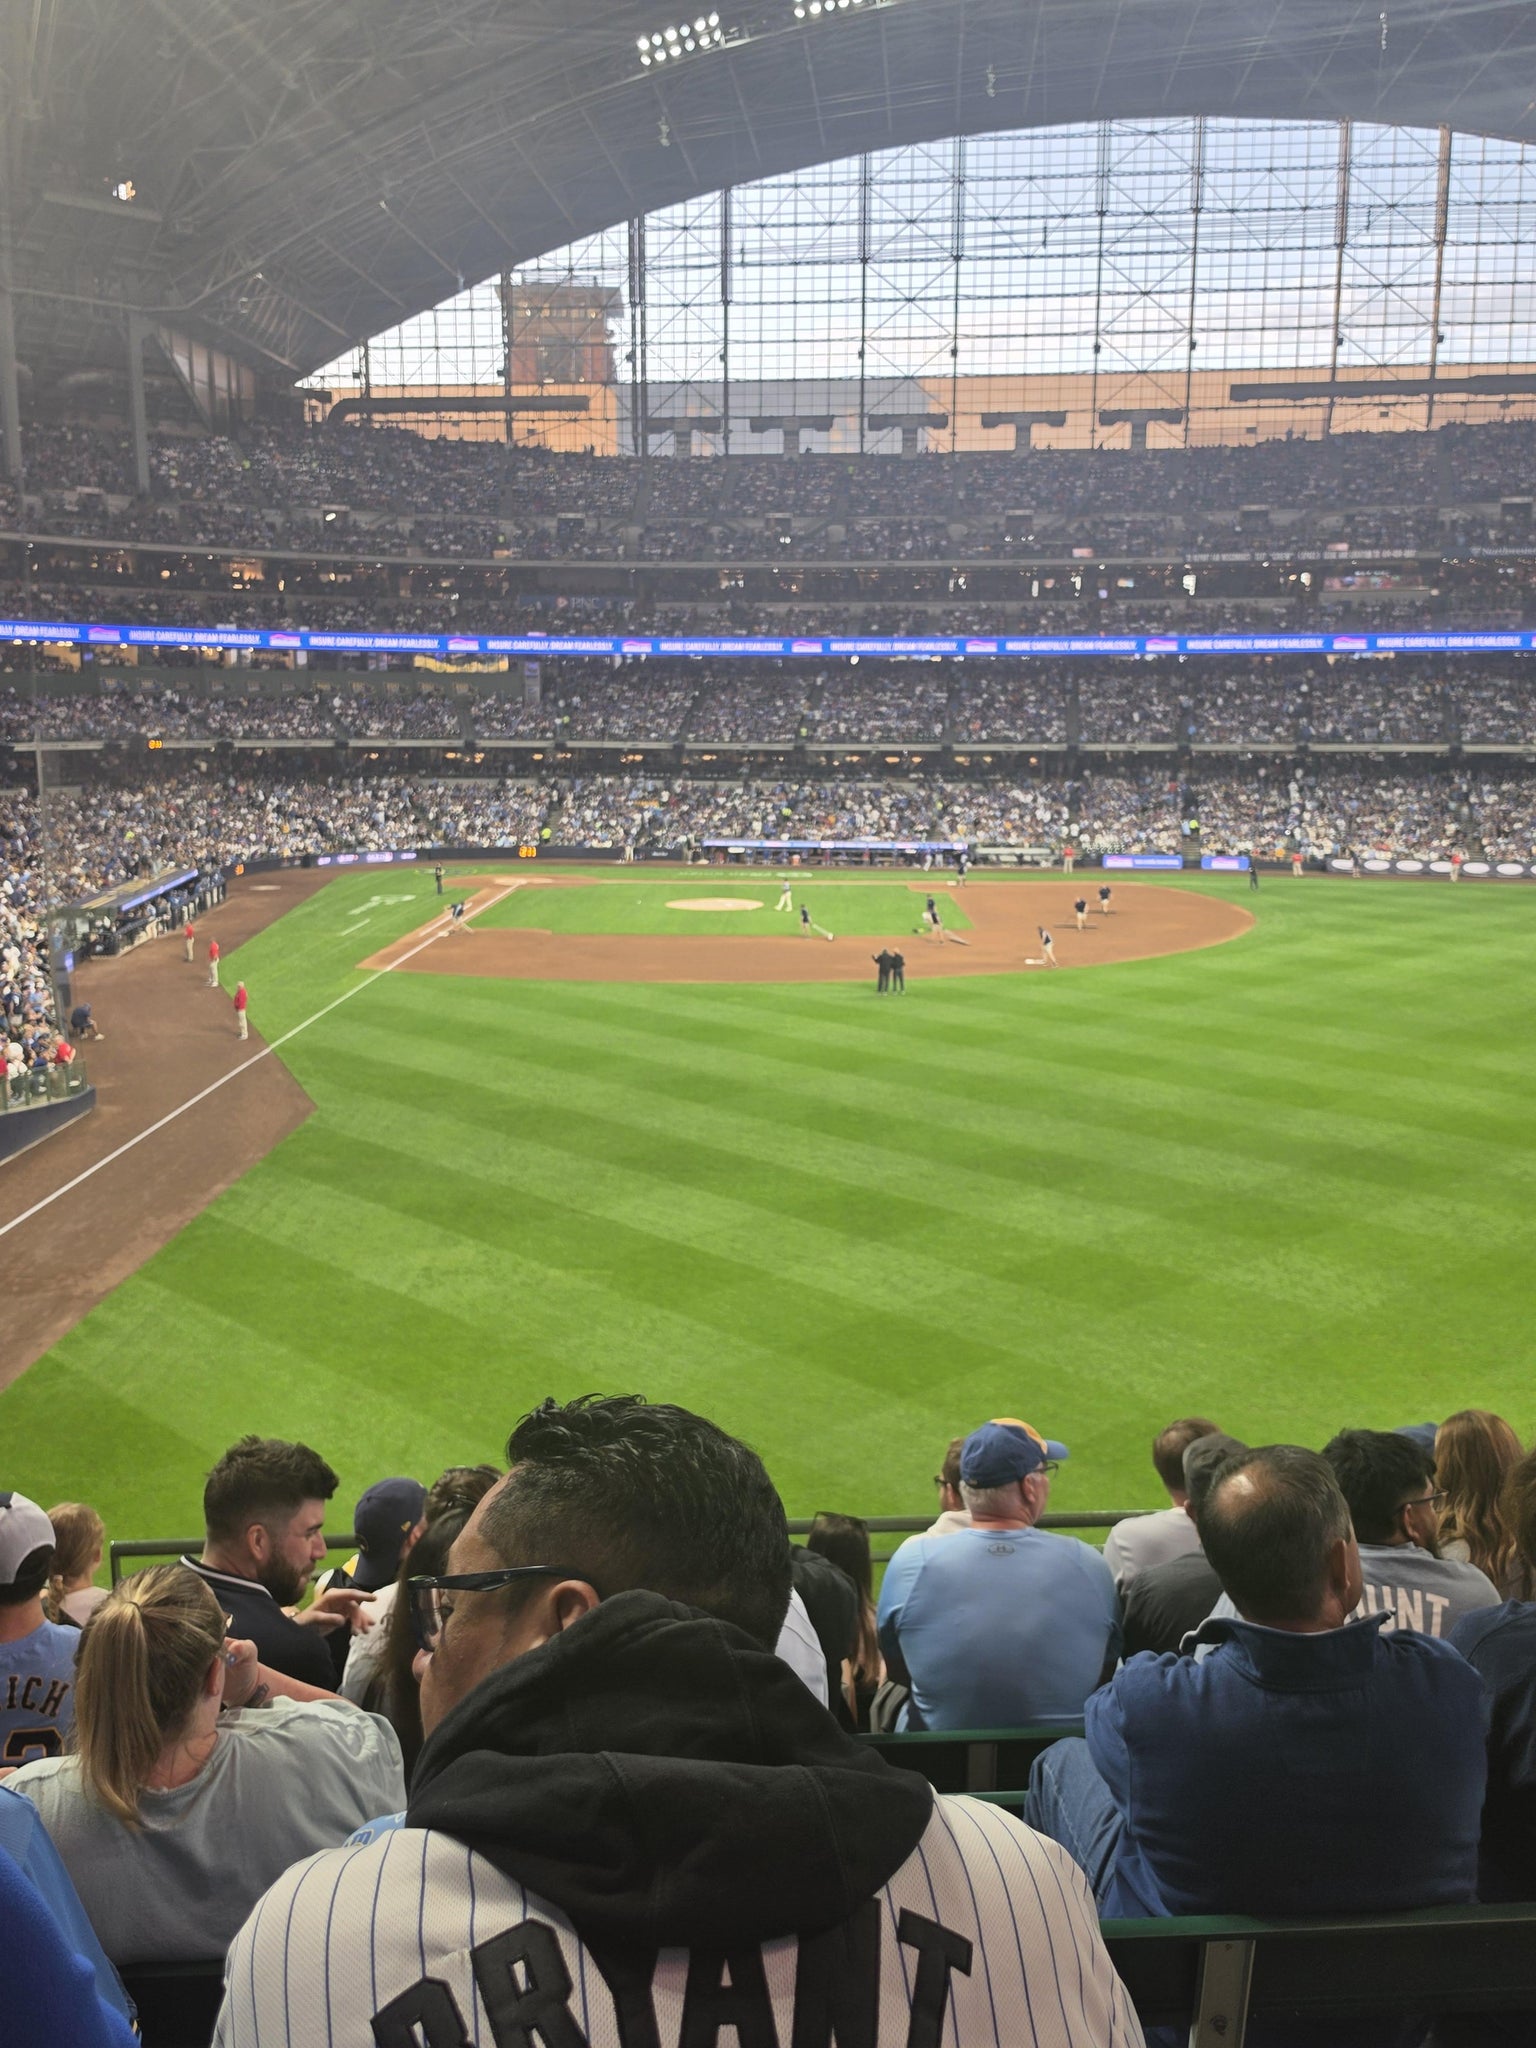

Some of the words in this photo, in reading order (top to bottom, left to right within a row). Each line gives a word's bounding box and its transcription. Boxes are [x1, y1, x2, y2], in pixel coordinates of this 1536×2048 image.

[309, 636, 335, 648] INSURE
[1344, 1584, 1449, 1638] UNT
[0, 1674, 70, 1718] ICH
